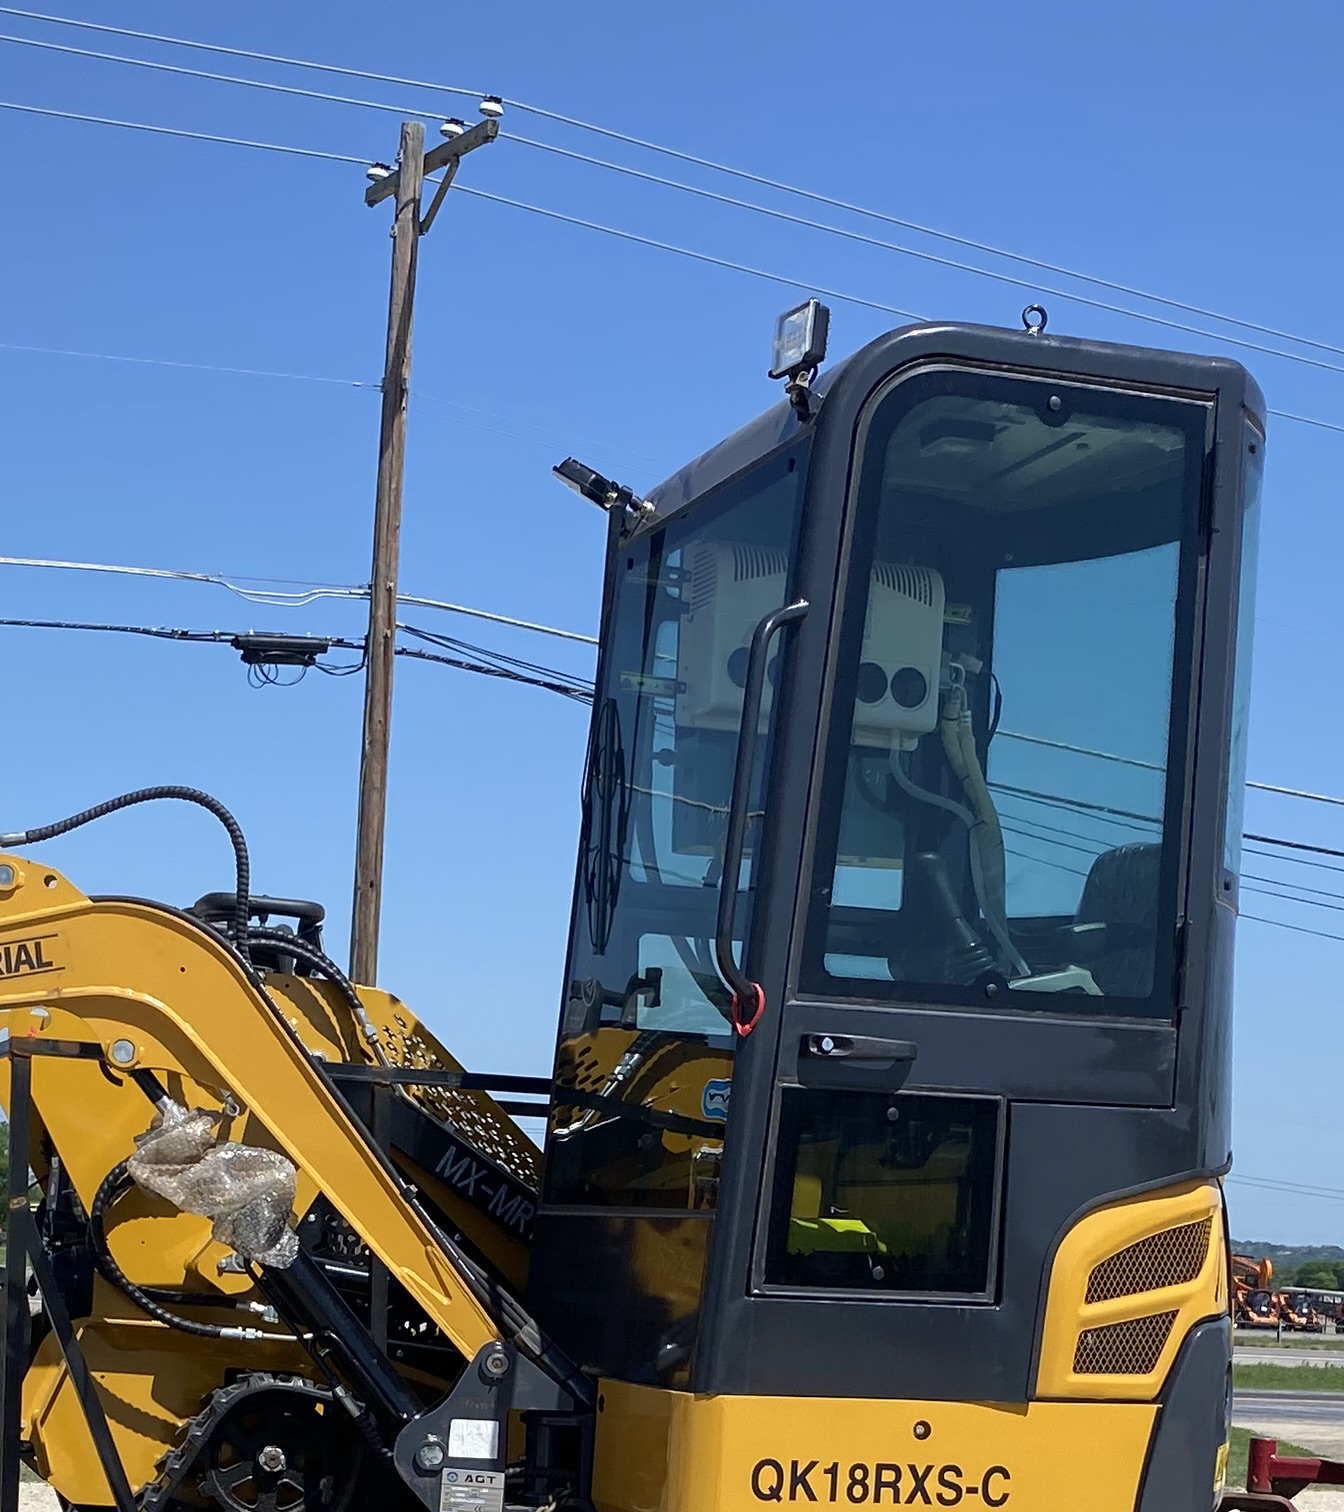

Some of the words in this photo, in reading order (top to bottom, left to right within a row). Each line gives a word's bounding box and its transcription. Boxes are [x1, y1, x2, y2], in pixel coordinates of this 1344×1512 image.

[435, 1145, 534, 1240] MX-MR
[464, 1474, 497, 1485] AGT
[751, 1457, 1011, 1507] QK18RXS-C
